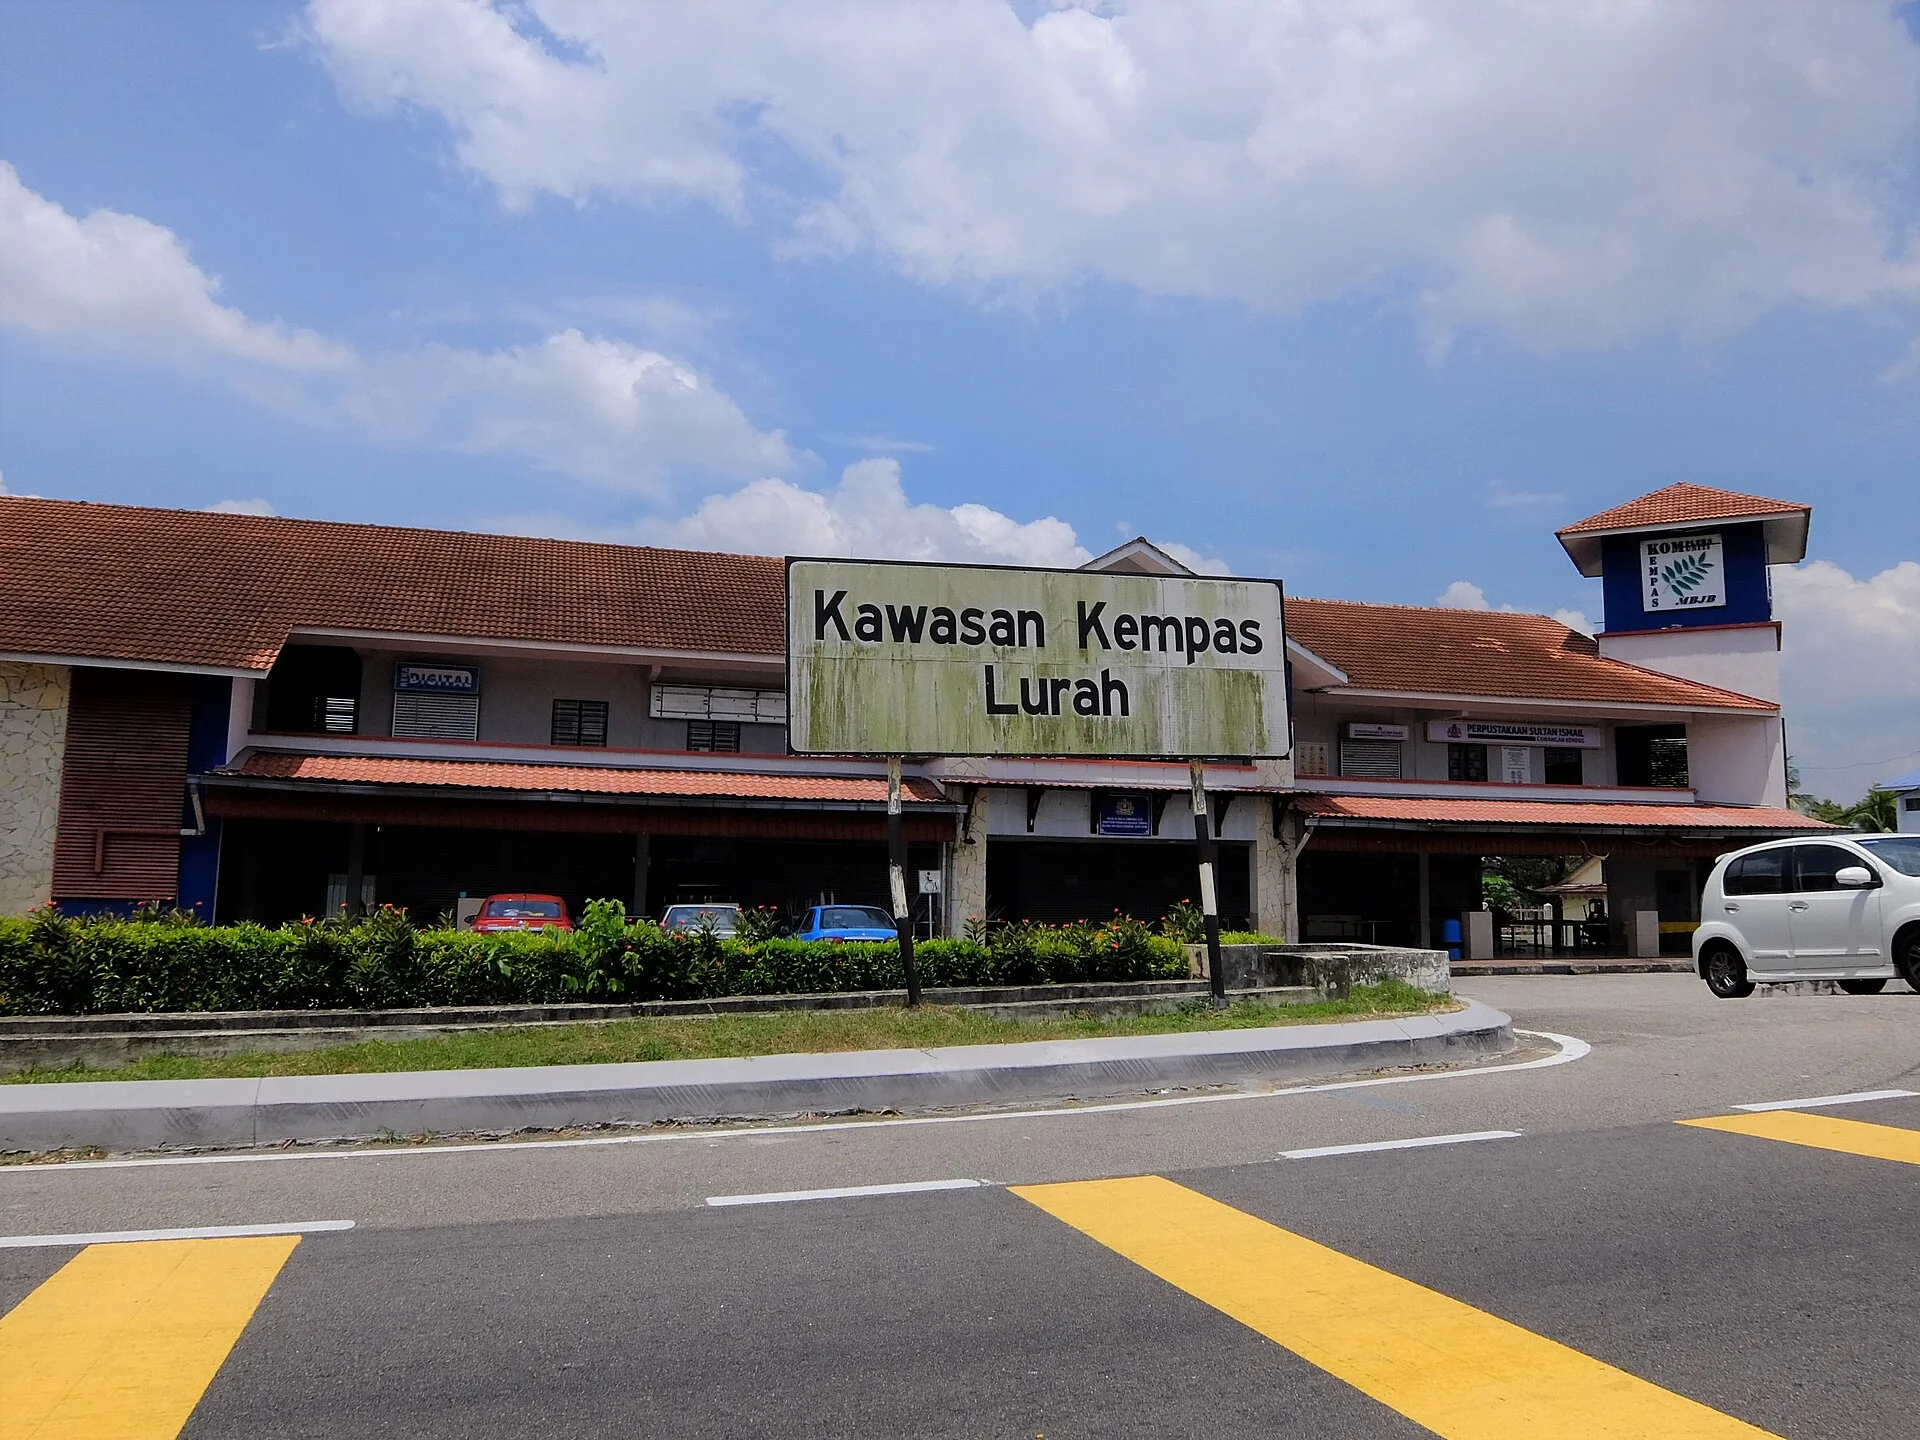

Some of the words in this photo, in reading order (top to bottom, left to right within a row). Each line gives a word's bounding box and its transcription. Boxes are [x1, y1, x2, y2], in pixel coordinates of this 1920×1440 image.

[814, 589, 1045, 649] Kawasan
[1077, 600, 1263, 664] Kempas
[409, 672, 472, 688] DIGITAL
[985, 664, 1130, 717] Lurah
[1466, 724, 1528, 735] PERPUSTAKAAN
[1529, 726, 1559, 736] SULTAN
[1559, 728, 1585, 737] ISMAIL
